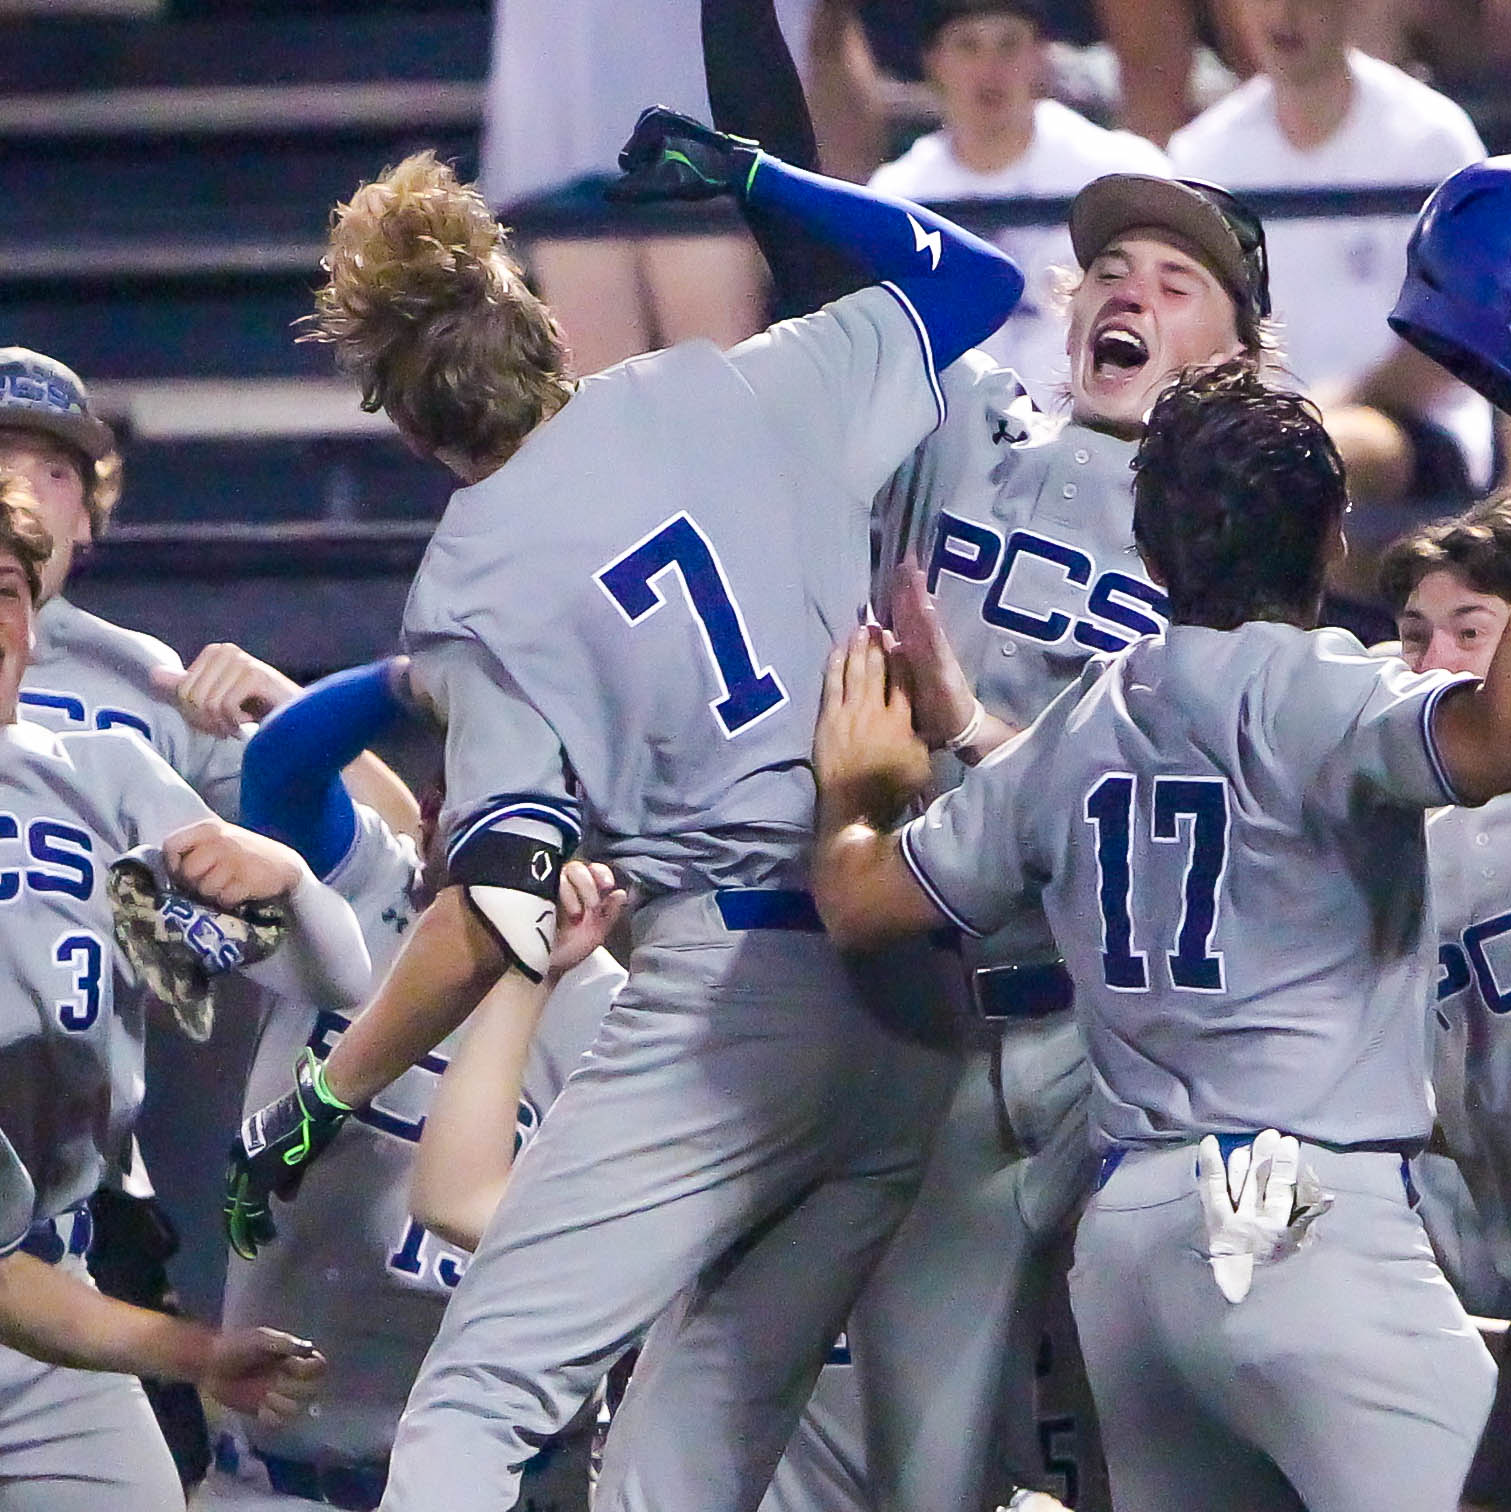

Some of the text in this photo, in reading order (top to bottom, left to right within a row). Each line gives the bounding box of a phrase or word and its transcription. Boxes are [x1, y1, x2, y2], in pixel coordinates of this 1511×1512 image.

[592, 509, 791, 741] 7
[925, 509, 1170, 653] PCS
[1082, 770, 1231, 995] 17
[53, 929, 103, 1034] 3
